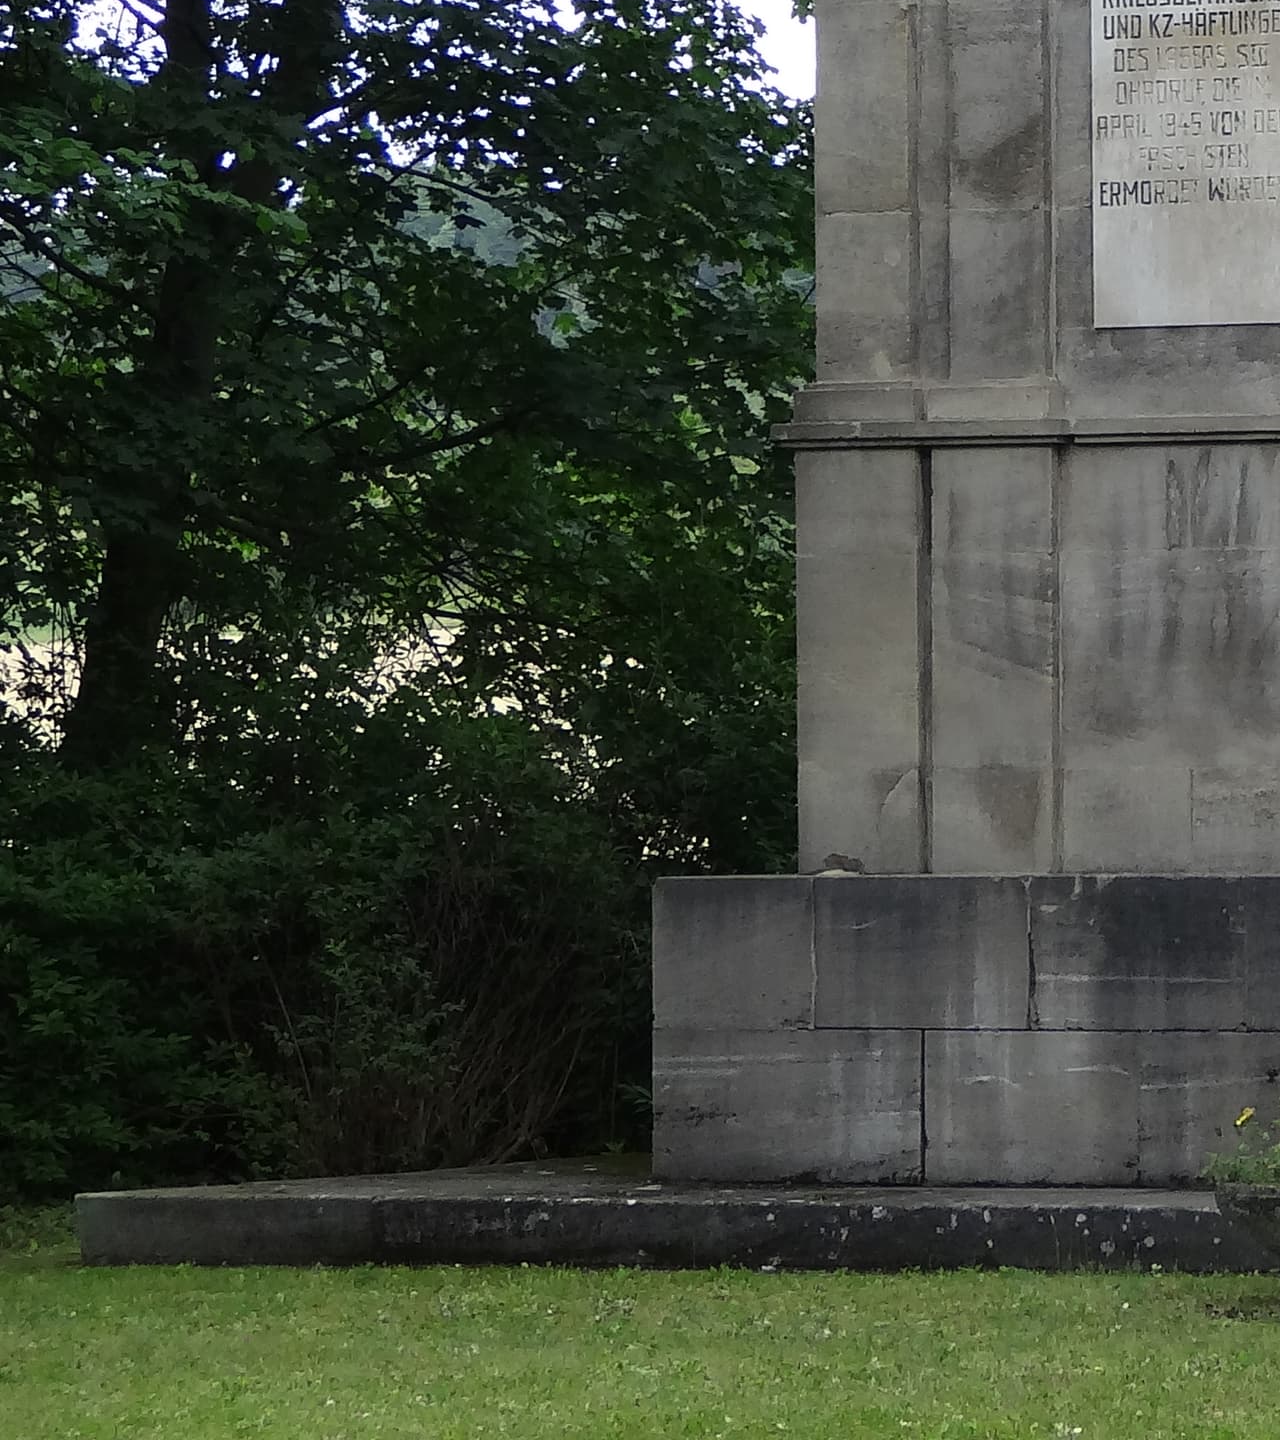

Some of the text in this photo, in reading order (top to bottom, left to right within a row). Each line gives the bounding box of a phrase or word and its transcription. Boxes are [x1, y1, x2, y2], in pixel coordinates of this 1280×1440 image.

[1103, 14, 1143, 41] UND
[1113, 48, 1150, 73] DES
[1096, 114, 1153, 141] APRIL
[1209, 109, 1247, 136] VON
